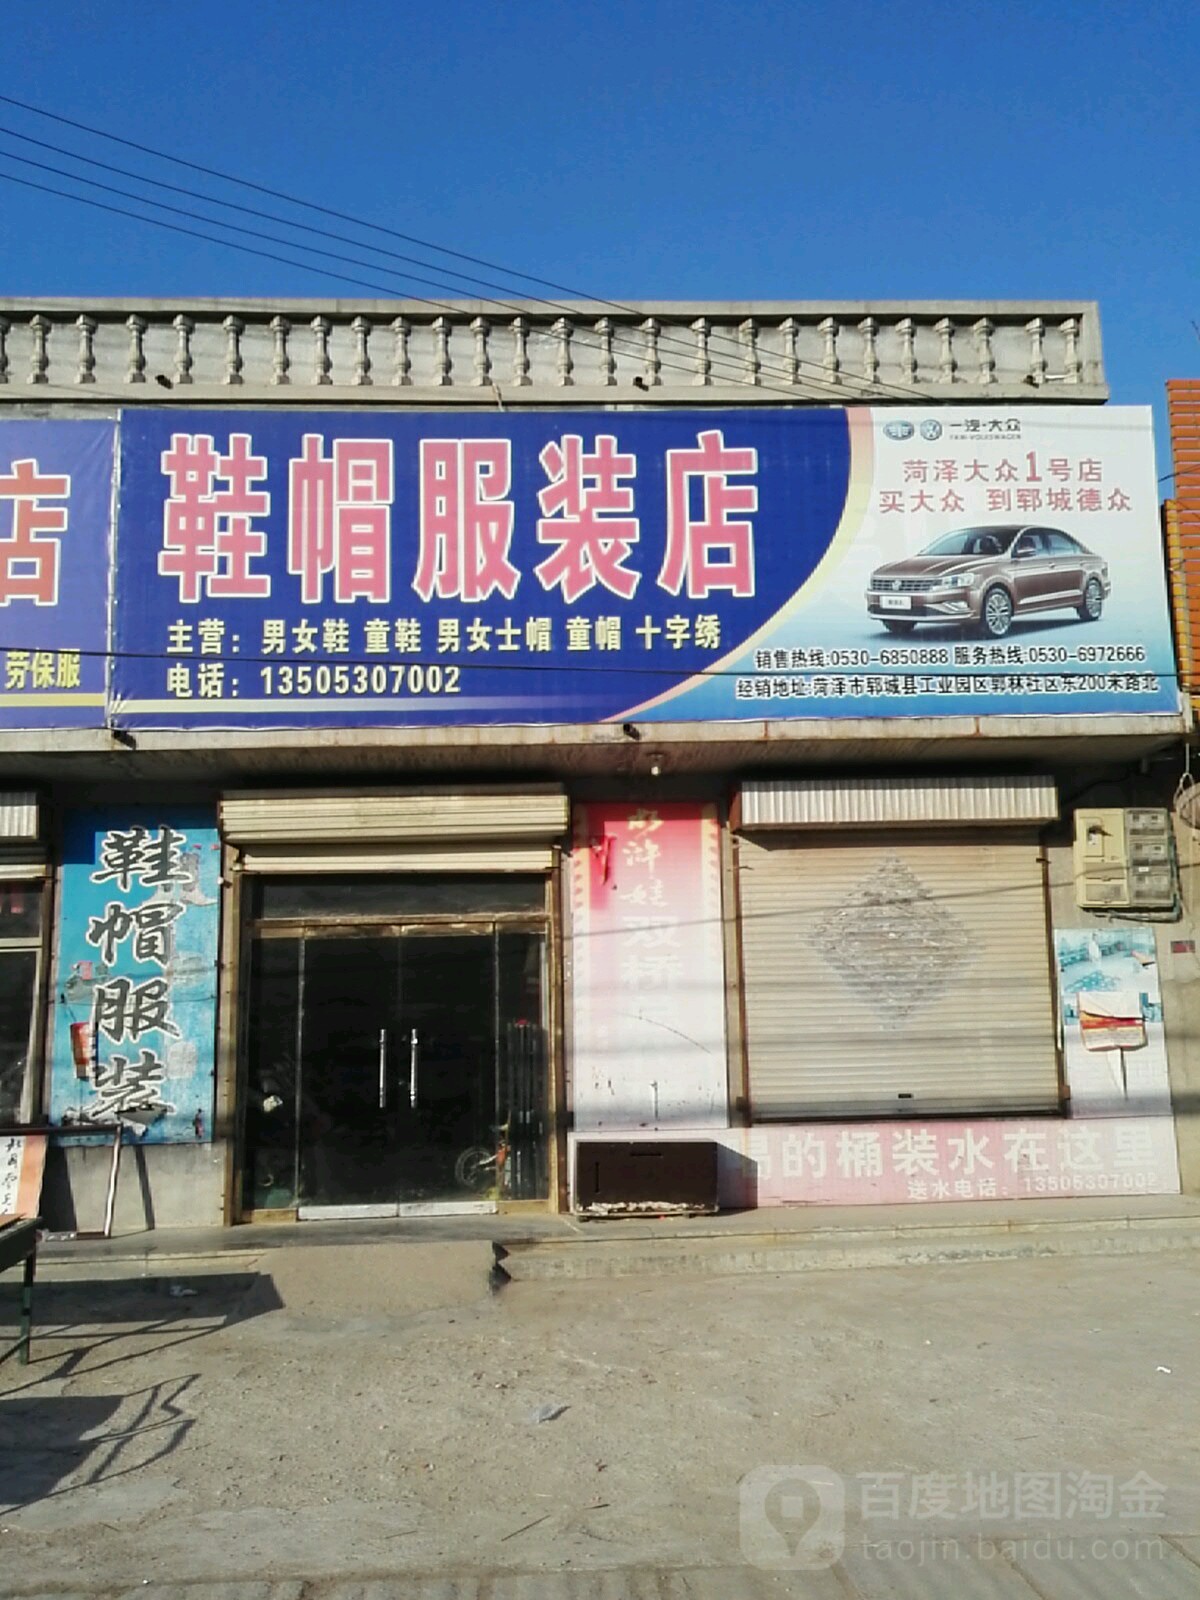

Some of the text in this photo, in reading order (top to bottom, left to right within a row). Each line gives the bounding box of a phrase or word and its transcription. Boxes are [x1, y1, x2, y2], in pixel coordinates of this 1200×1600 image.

[903, 451, 1103, 484] 菏泽大众1号店
[157, 430, 759, 604] 鞋帽服装店
[879, 486, 1132, 514] 买大众 到郓城德众
[0, 458, 71, 606] 店
[260, 618, 350, 654] 男女鞋
[364, 618, 422, 653] 童鞋
[437, 616, 552, 653] 男女士帽
[565, 615, 622, 651] 童帽
[635, 613, 721, 650] 十字绣
[5, 649, 81, 690] 劳保服
[259, 665, 461, 695] 13505307002
[88, 826, 195, 1124] 鞋帽服装
